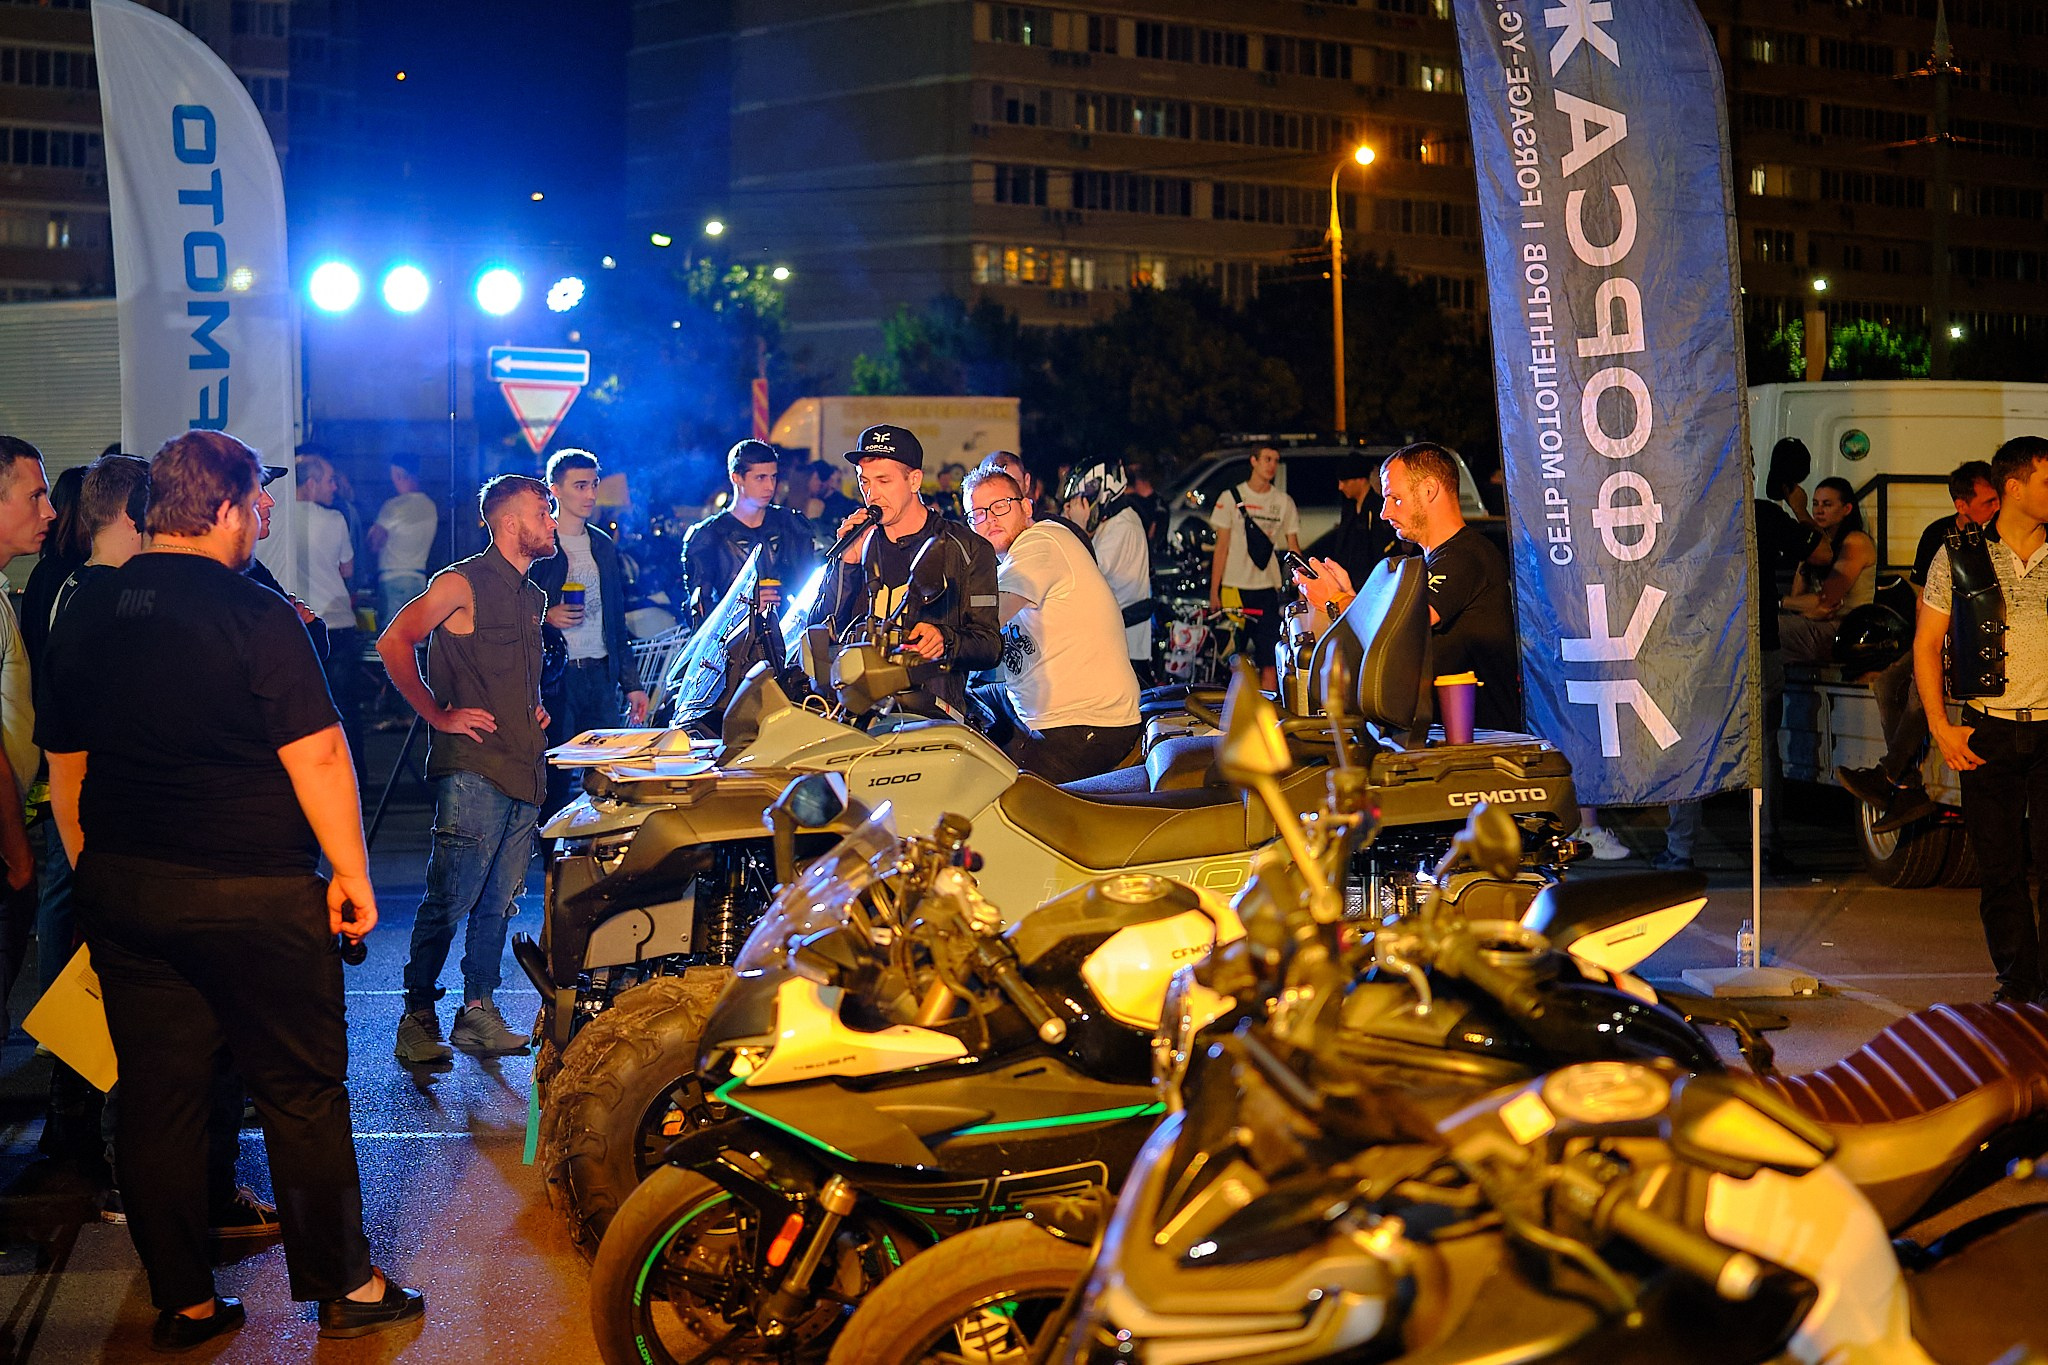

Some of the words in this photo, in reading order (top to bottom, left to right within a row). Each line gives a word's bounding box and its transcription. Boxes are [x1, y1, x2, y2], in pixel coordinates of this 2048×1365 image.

[868, 772, 922, 788] 1000
[1447, 787, 1548, 807] CFMOTO
[1171, 943, 1212, 959] CFMO
[635, 1334, 654, 1365] MOTO
